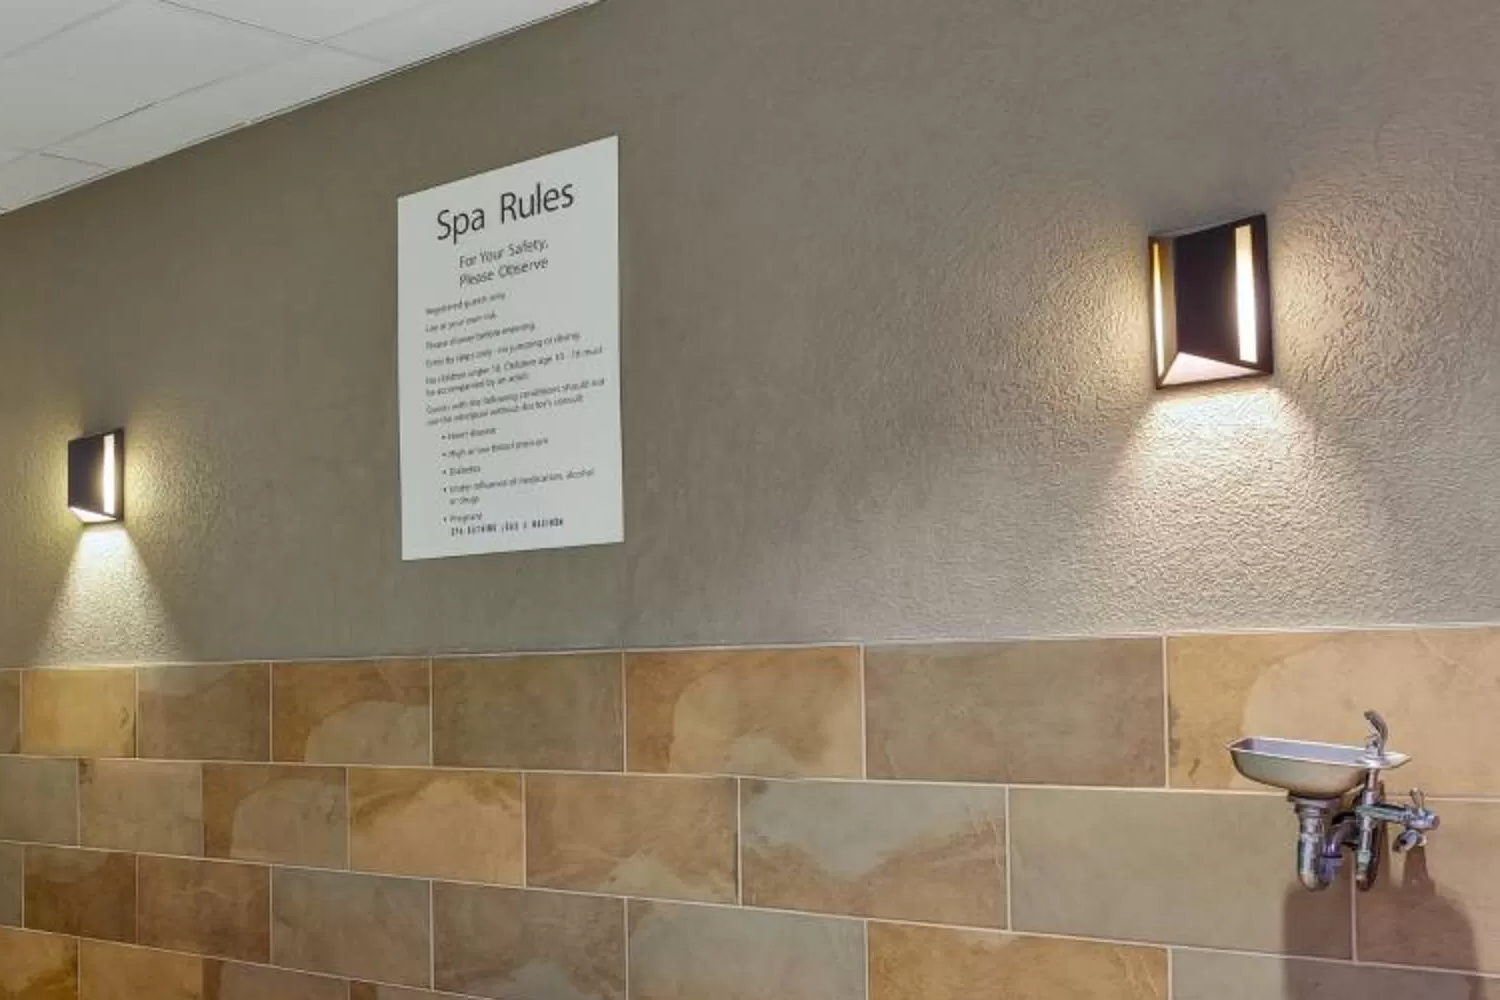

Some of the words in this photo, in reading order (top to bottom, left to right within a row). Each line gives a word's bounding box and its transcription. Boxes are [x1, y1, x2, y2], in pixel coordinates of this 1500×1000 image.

[436, 207, 485, 244] Spa
[501, 182, 574, 224] Rules
[459, 254, 477, 269] For
[479, 247, 505, 264] Your
[459, 270, 494, 288] Please
[498, 258, 549, 279] Observe
